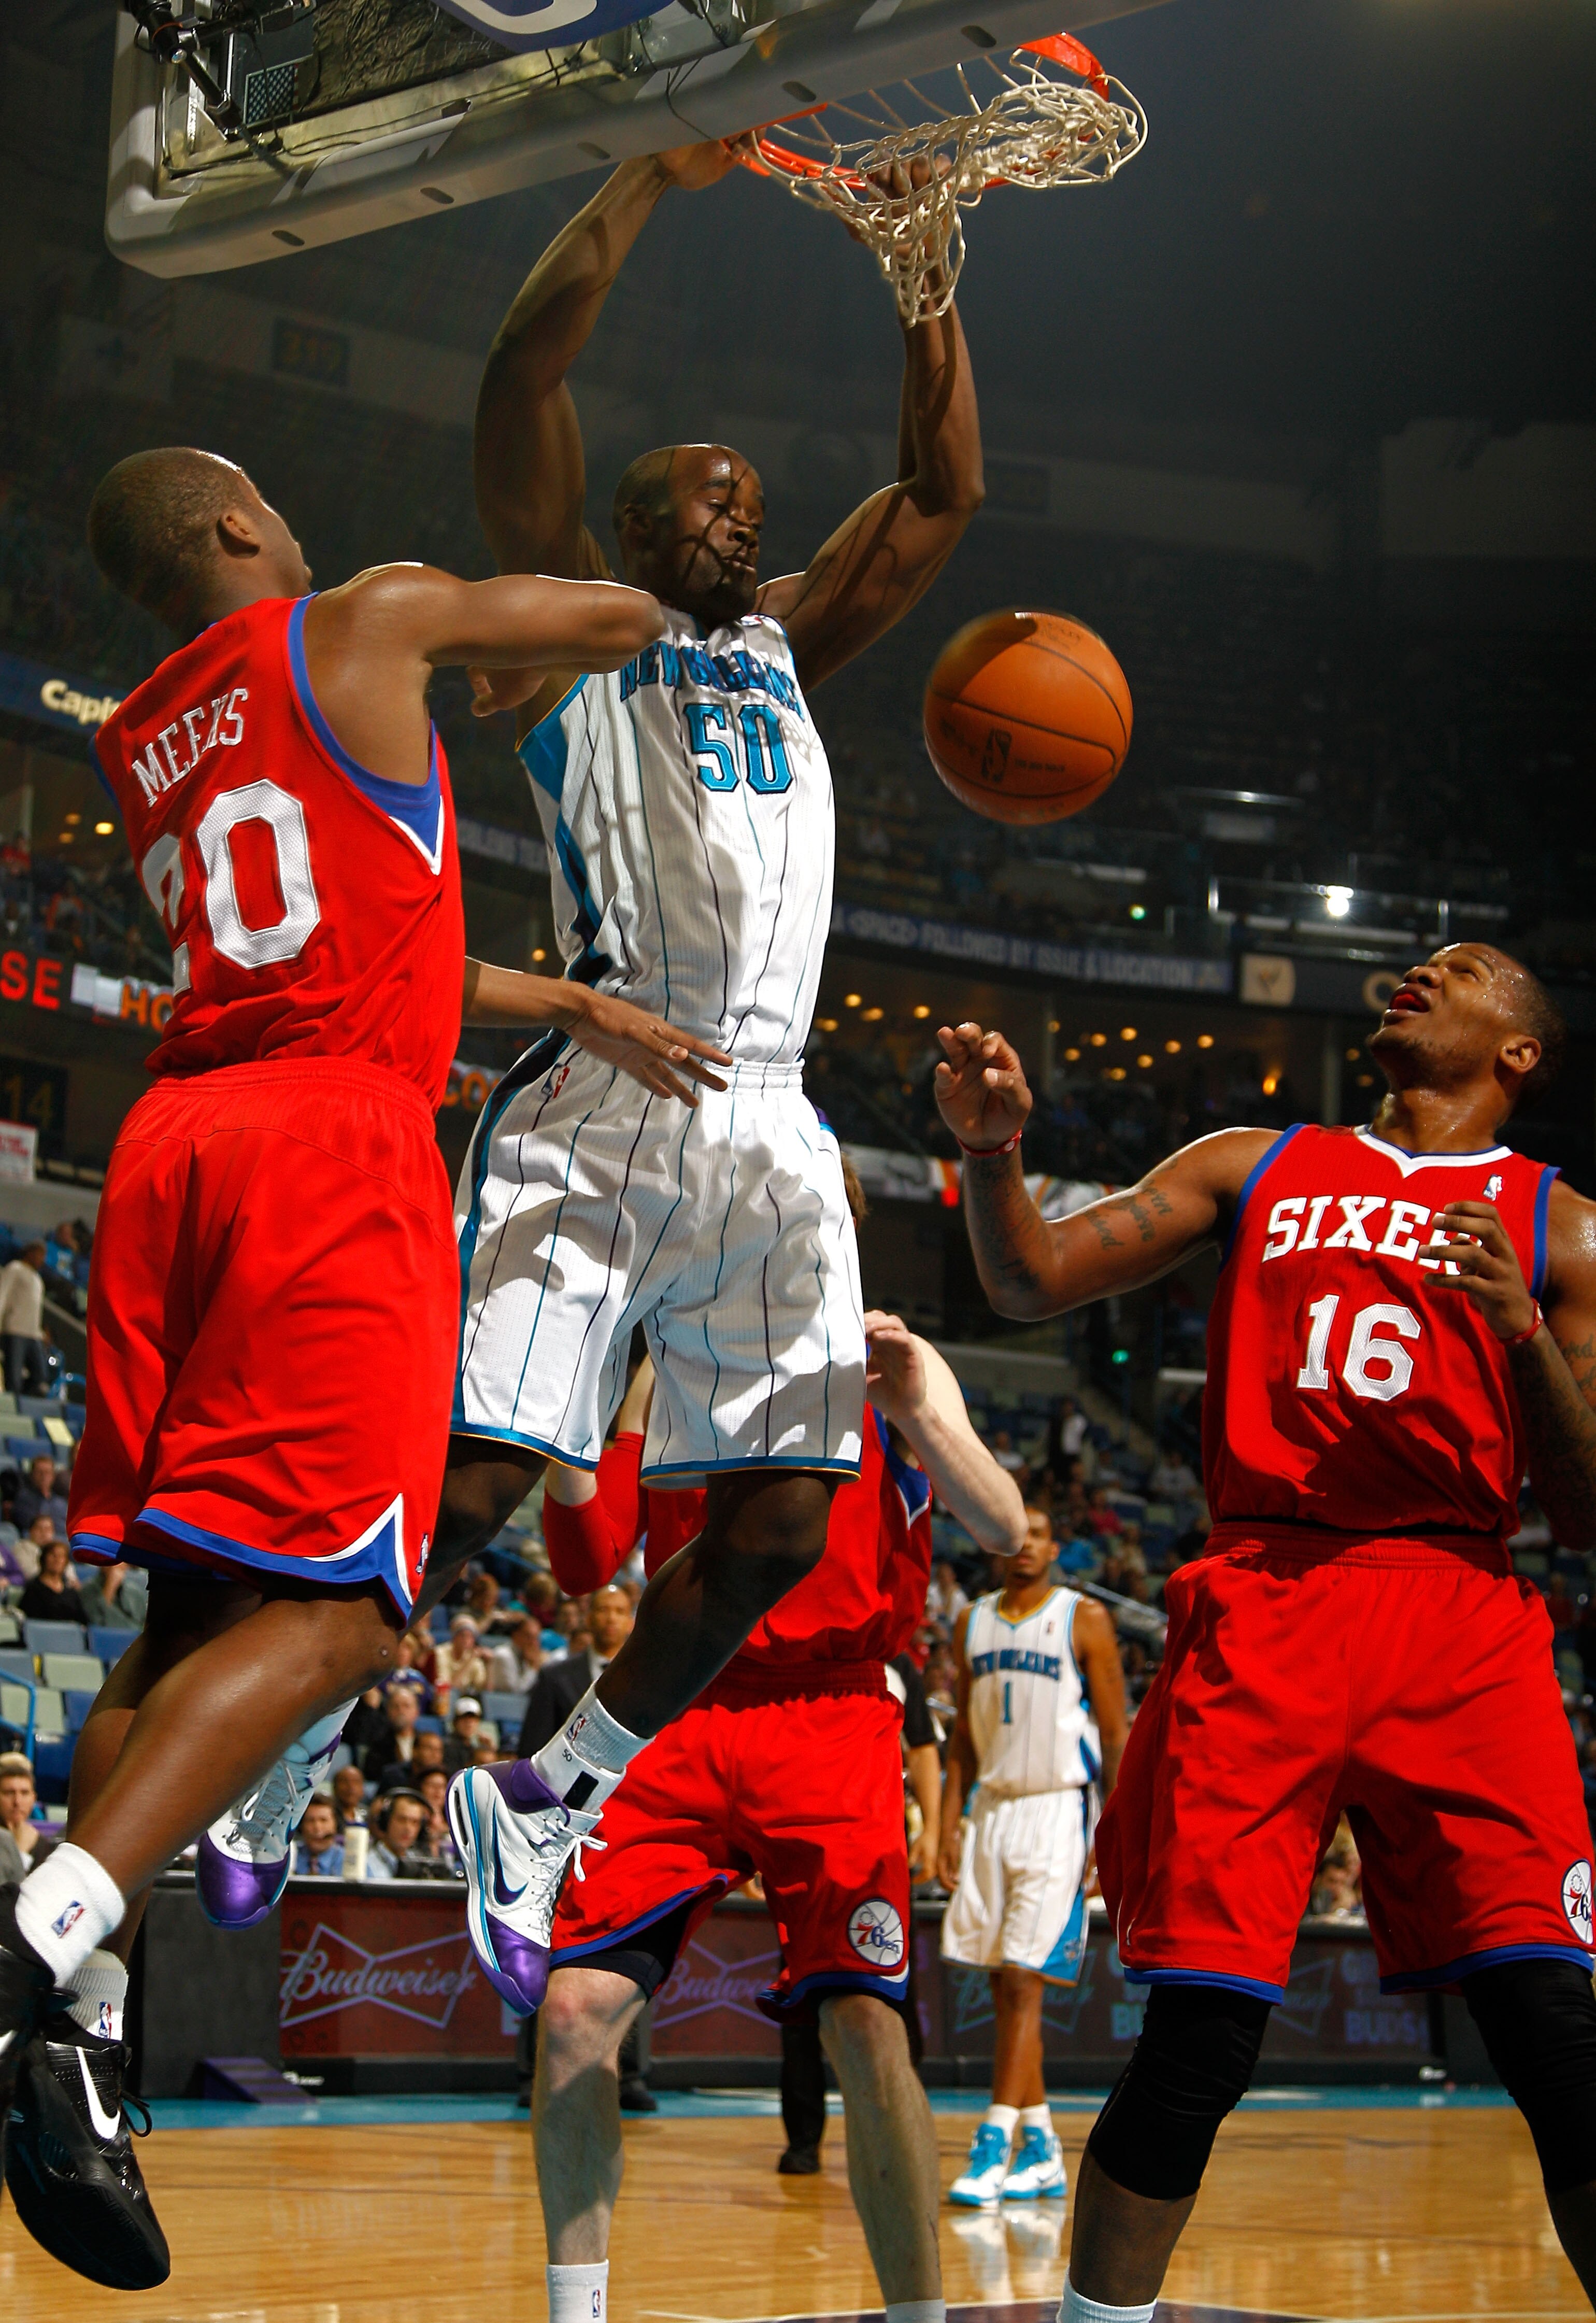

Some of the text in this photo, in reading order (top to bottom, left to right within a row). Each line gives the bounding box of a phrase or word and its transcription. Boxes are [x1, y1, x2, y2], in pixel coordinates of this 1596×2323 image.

[41, 678, 121, 726] Capi
[620, 641, 682, 702] NEW
[131, 687, 249, 808] MEEKS
[683, 703, 794, 794] 50
[141, 778, 321, 996] 20
[1262, 1196, 1483, 1276] SIXE
[1296, 1294, 1421, 1402] 16
[1004, 1681, 1011, 1723] 1
[562, 1748, 573, 1762] 50
[280, 1948, 477, 2002] Budweiser
